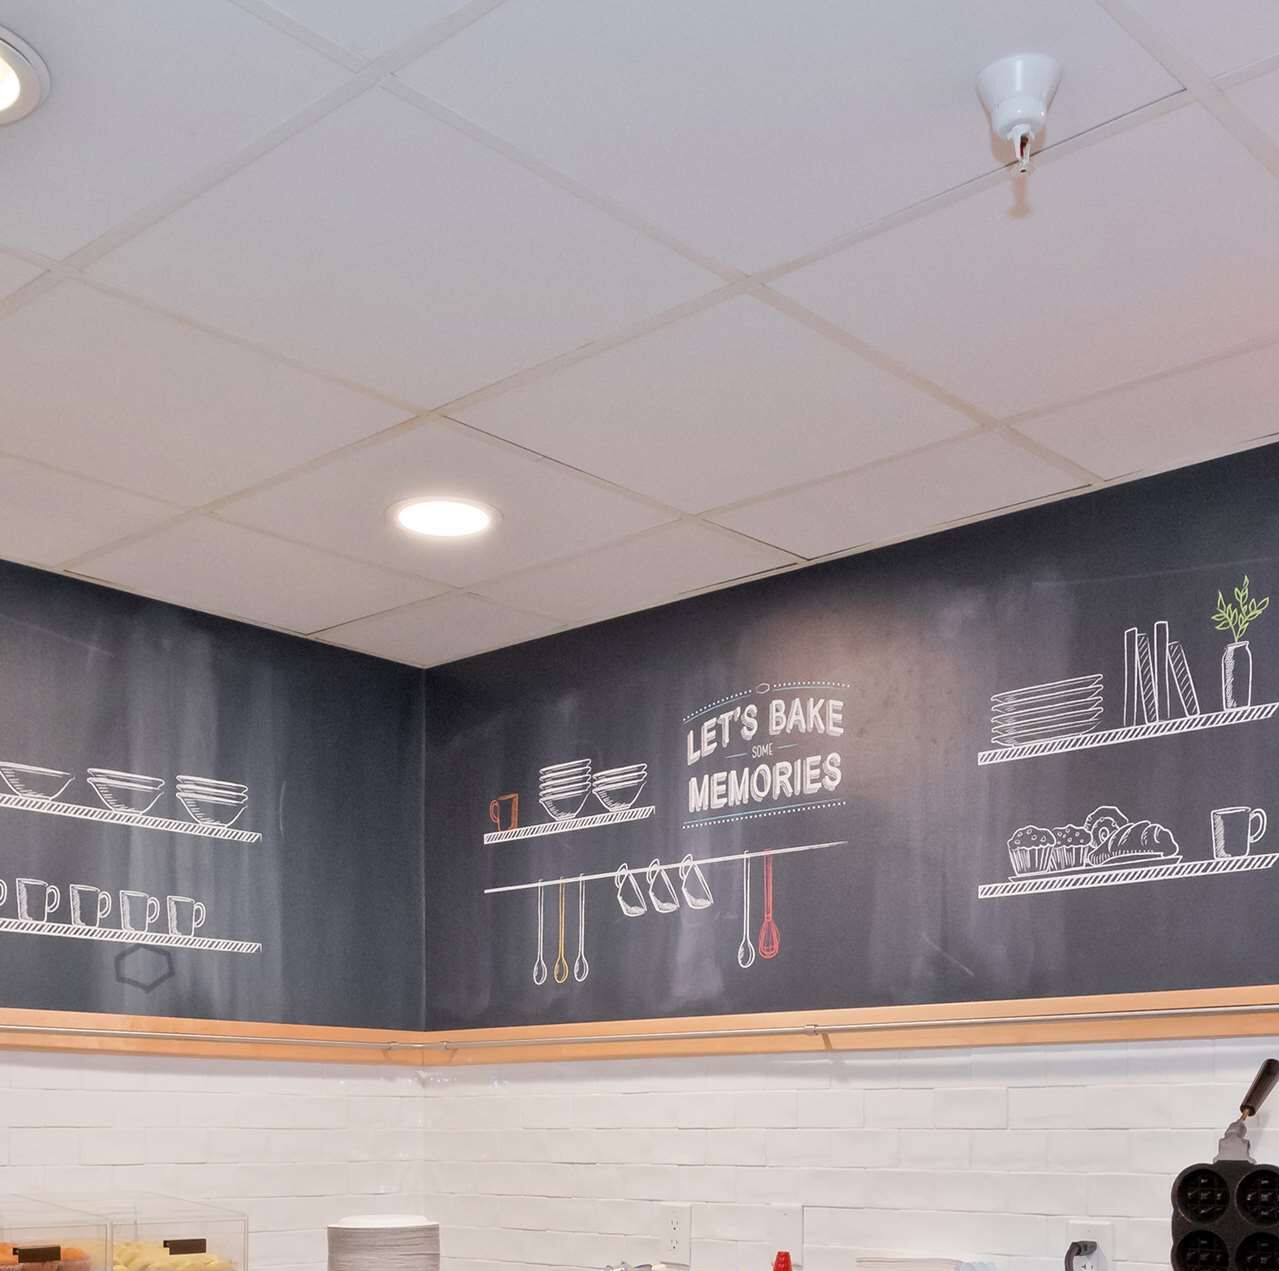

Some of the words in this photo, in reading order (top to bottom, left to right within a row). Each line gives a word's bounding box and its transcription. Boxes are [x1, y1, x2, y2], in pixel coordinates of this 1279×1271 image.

[686, 704, 759, 765] LET'S
[769, 698, 844, 736] BAKE
[751, 742, 773, 759] SOME
[688, 752, 843, 813] MEMORIES
